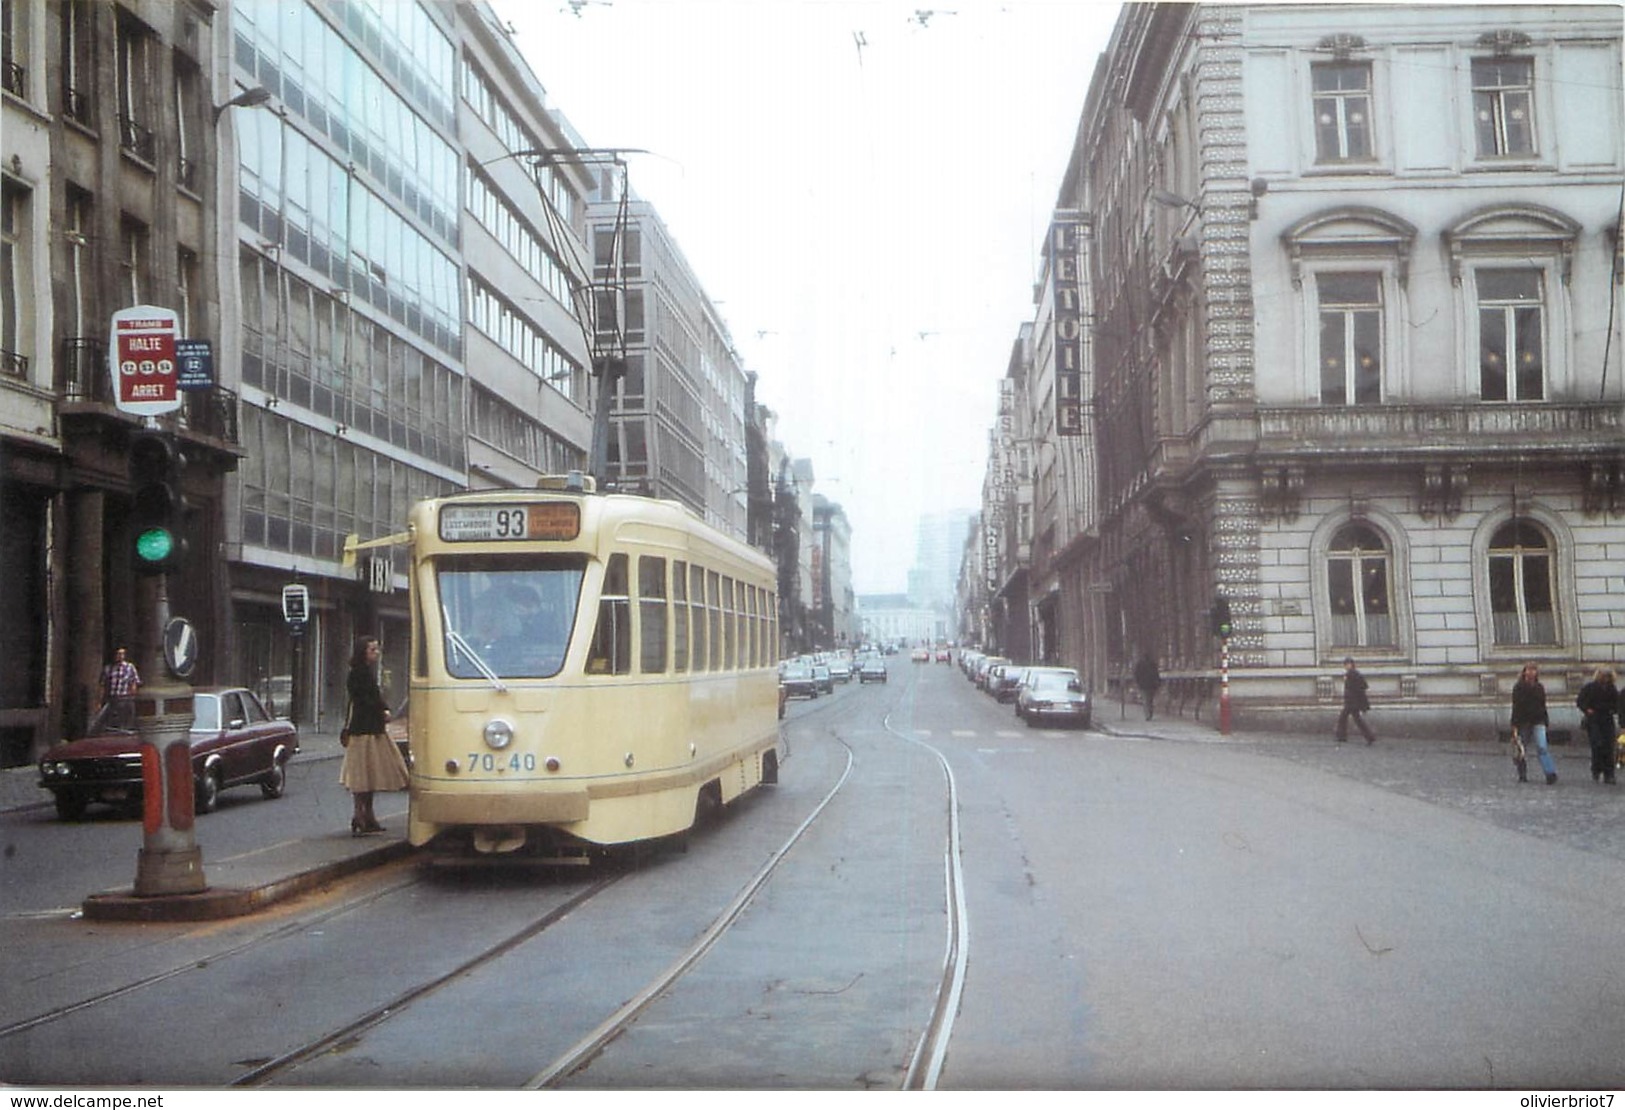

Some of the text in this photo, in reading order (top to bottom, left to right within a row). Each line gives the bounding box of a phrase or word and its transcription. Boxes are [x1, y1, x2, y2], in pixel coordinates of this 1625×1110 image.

[129, 337, 162, 351] HALTE
[132, 384, 165, 397] ARRET
[496, 509, 525, 537] 93
[369, 557, 395, 595] IBM
